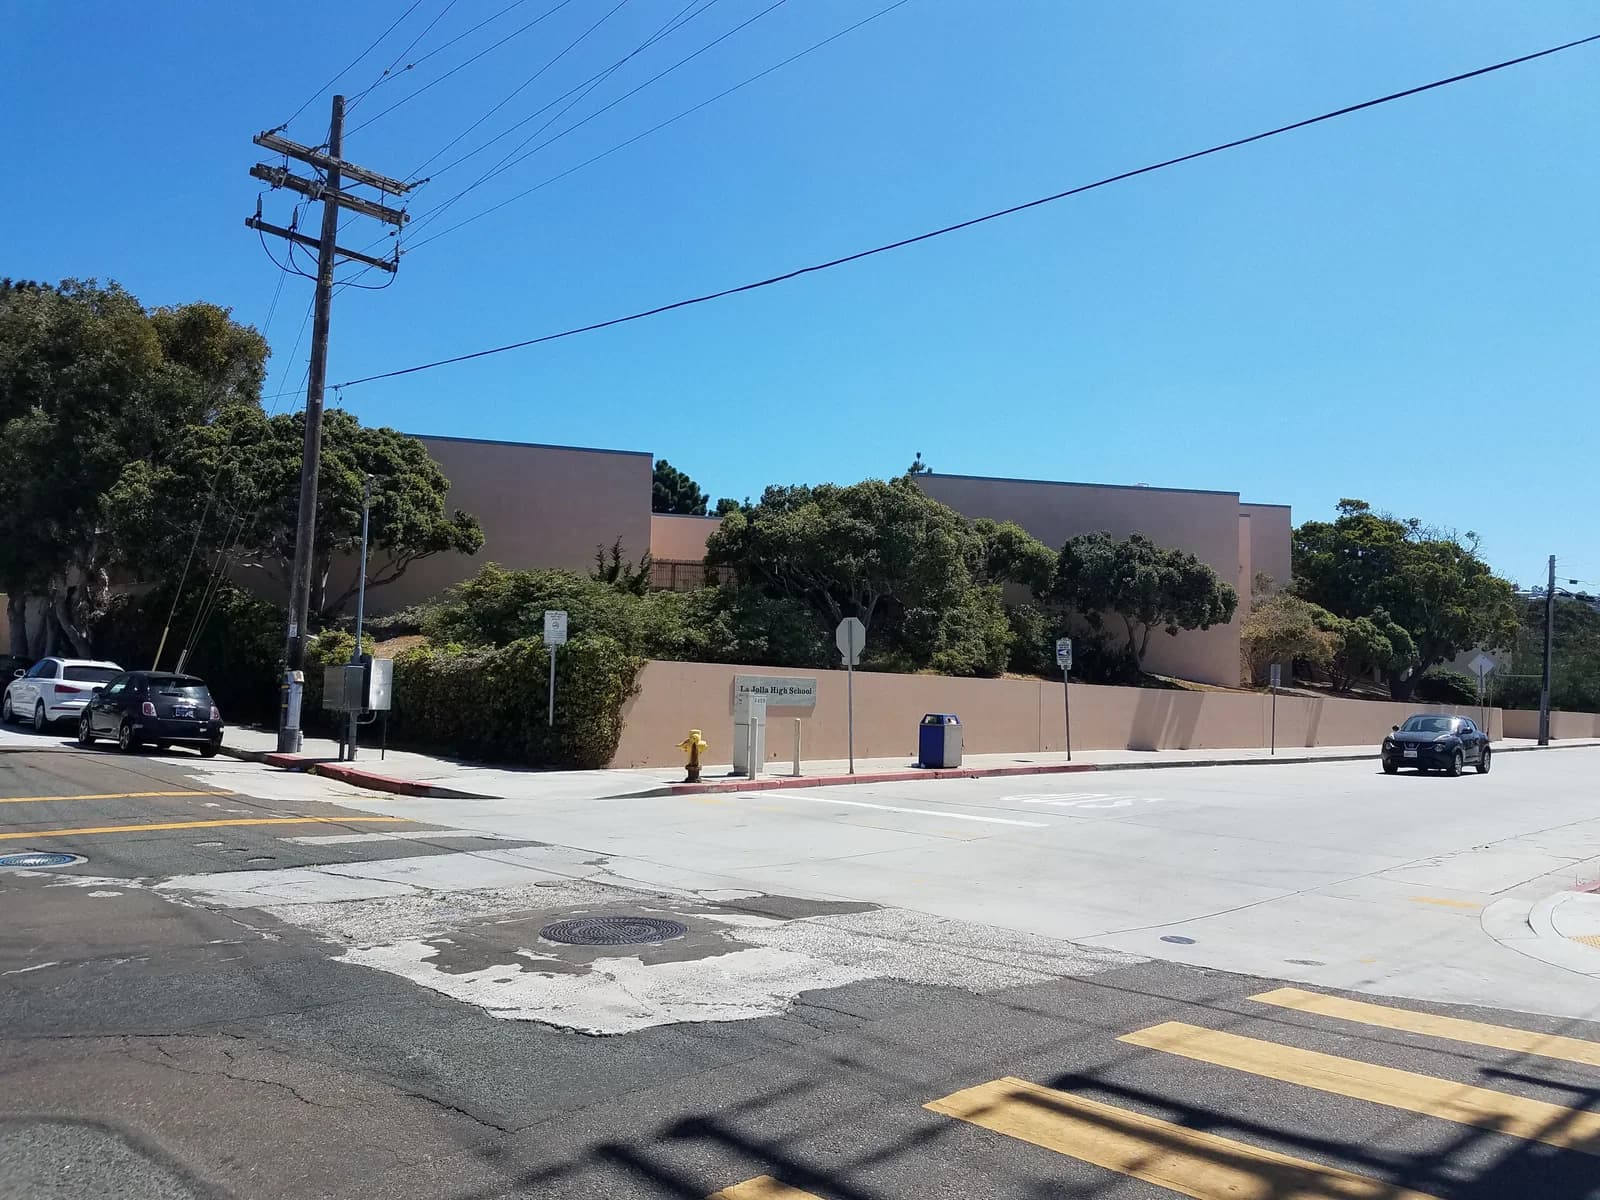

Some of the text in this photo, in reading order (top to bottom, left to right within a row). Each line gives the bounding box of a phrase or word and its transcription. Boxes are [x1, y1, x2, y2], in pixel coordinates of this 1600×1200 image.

[740, 685, 812, 695] La Jolla High School
